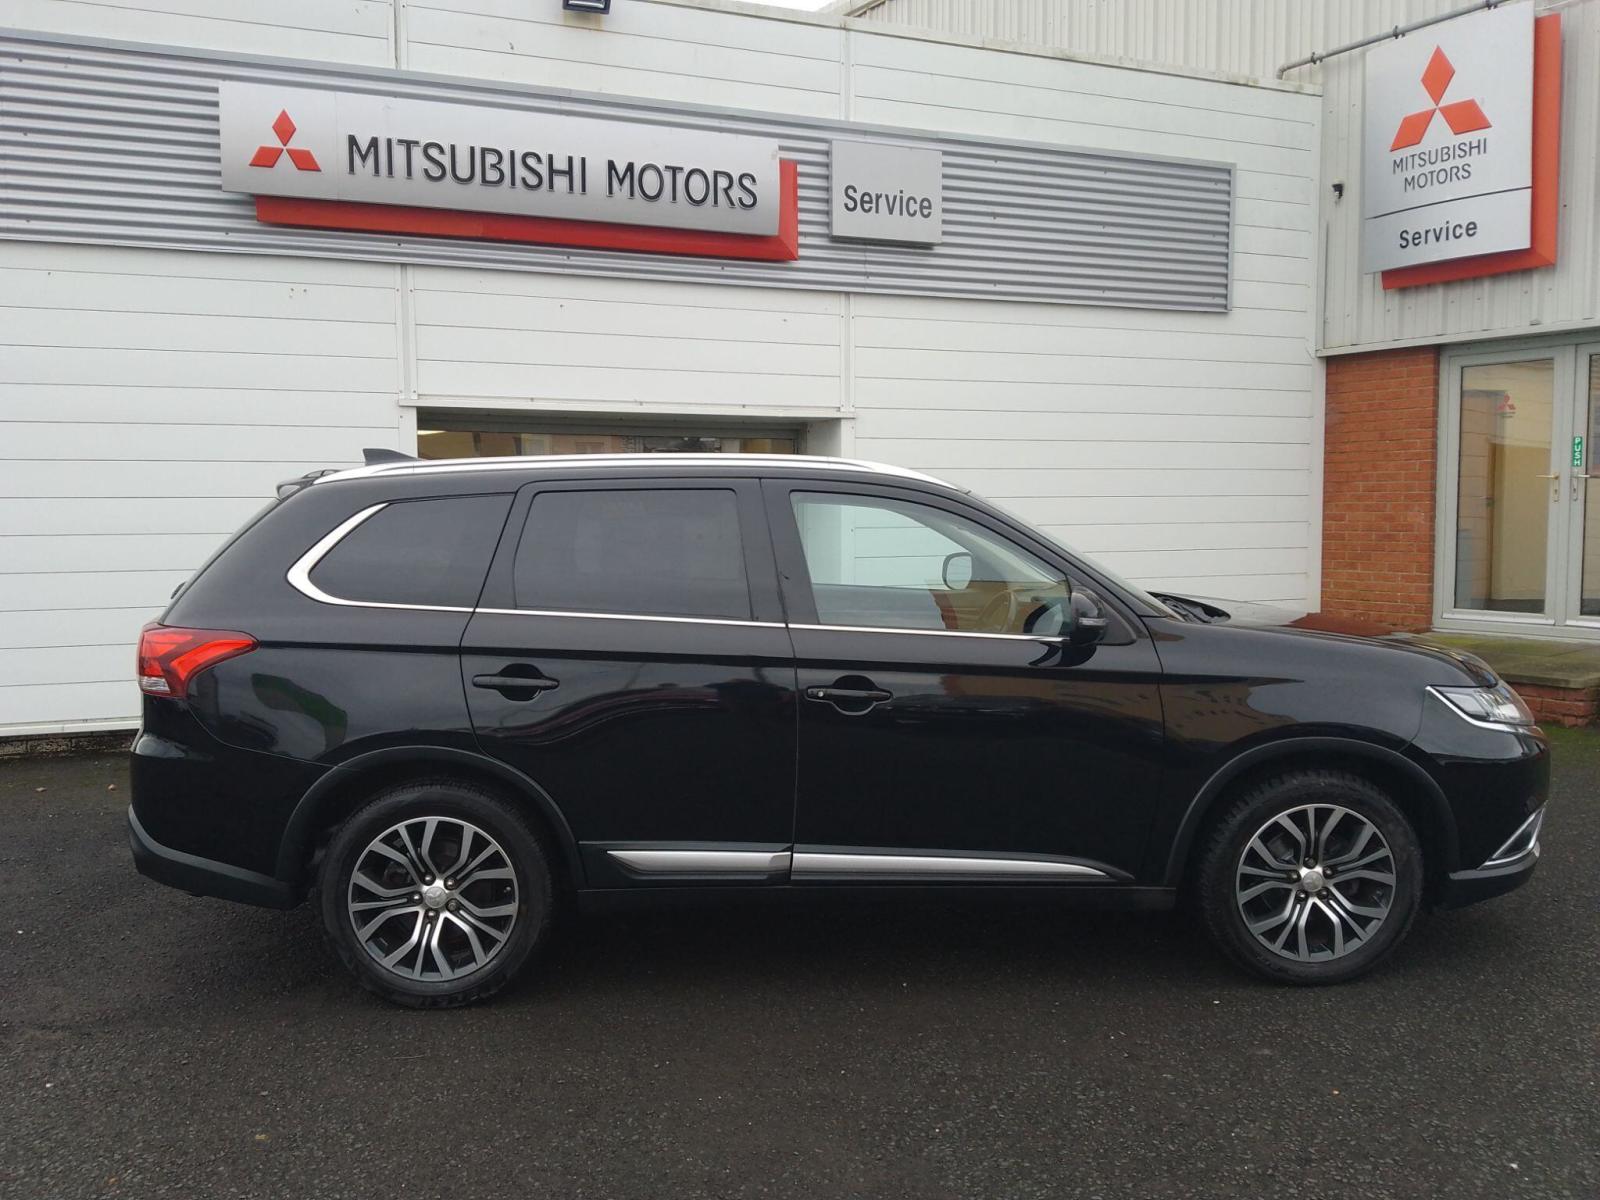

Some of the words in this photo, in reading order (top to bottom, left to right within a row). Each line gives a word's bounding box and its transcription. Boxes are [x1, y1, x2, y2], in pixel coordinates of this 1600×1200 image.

[347, 133, 588, 195] MITSUBISHI
[606, 158, 758, 210] MOTORS
[1392, 138, 1488, 175] MITSUBISHI
[1403, 164, 1472, 193] MOTORS
[843, 184, 933, 219] Service
[1399, 220, 1478, 249] Service
